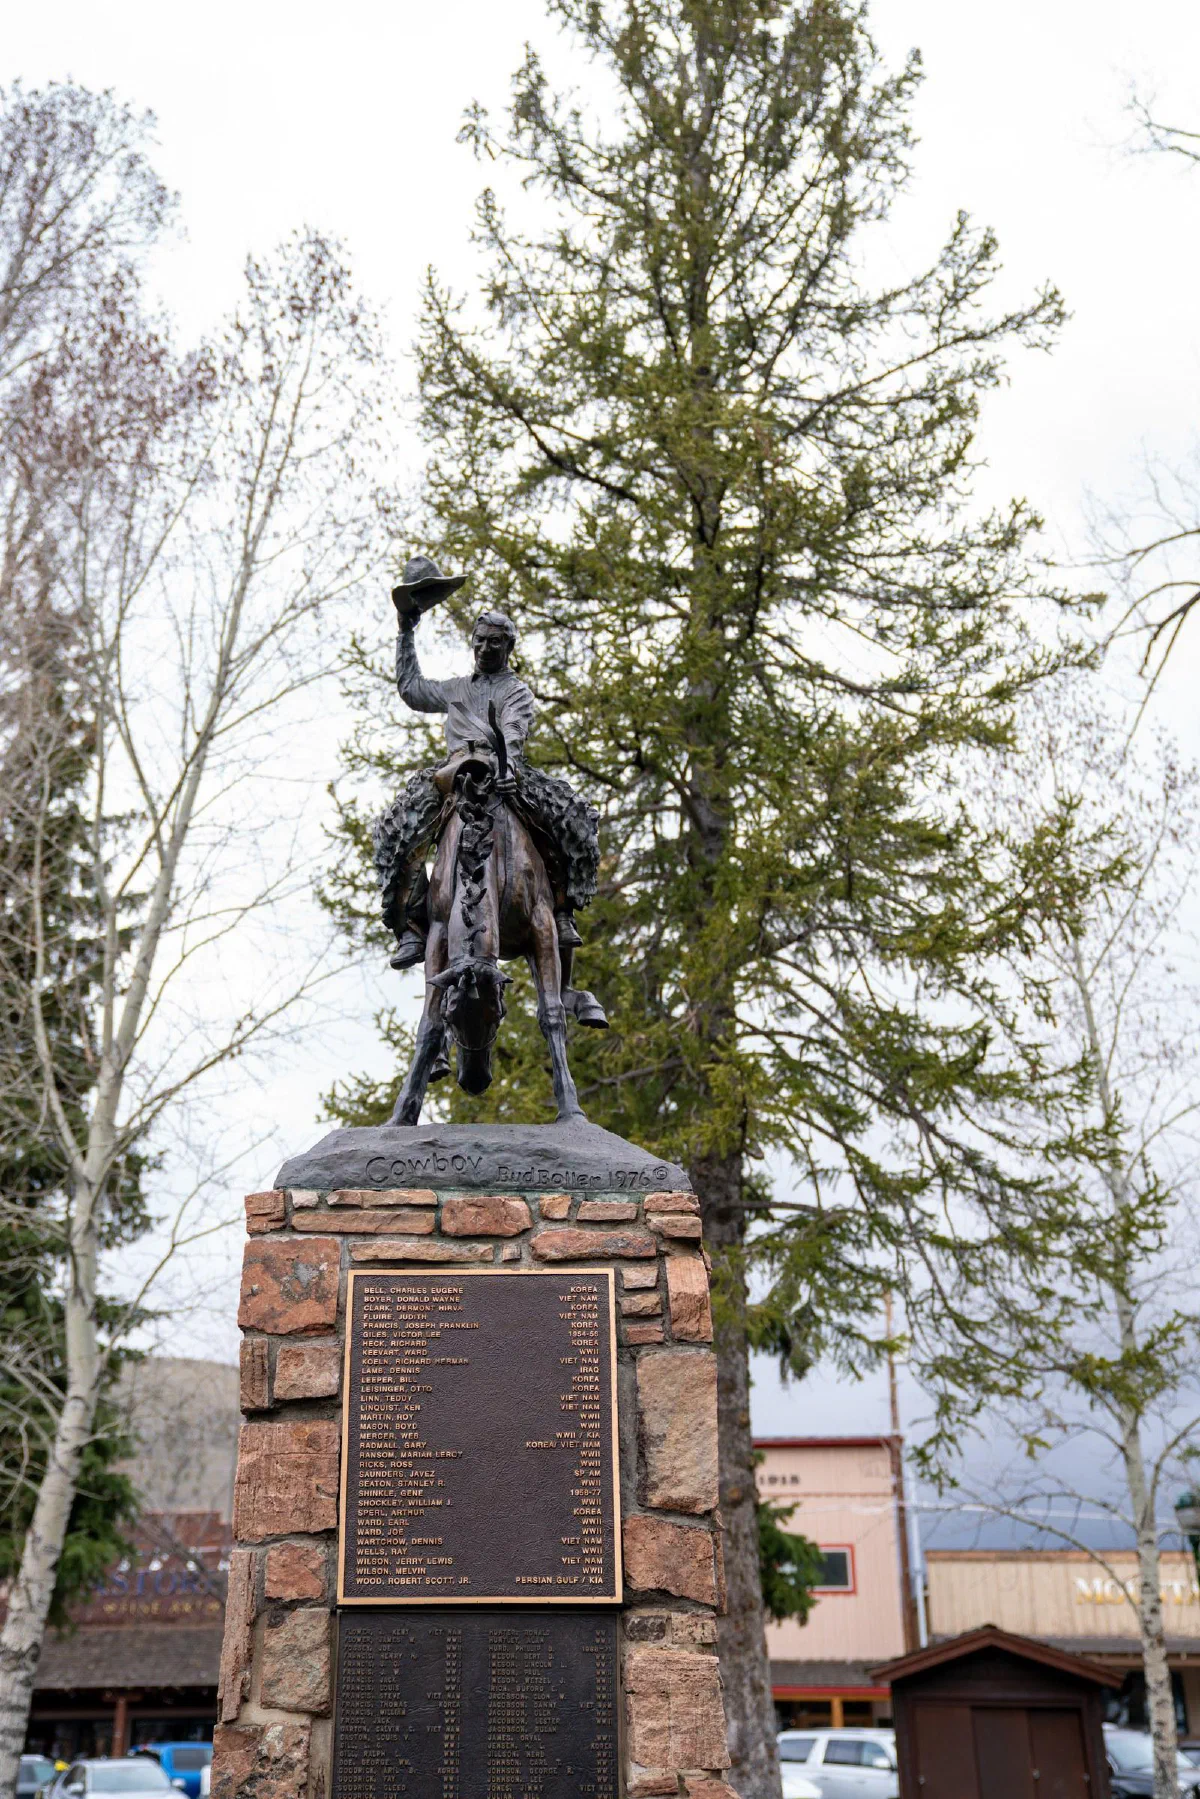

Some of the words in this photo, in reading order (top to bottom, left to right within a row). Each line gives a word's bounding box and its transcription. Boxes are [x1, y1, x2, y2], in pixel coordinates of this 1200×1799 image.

[365, 1152, 483, 1183] Cowboy
[496, 1166, 535, 1183] Bud
[608, 1170, 651, 1188] 1976
[356, 1567, 392, 1575] WILSON,
